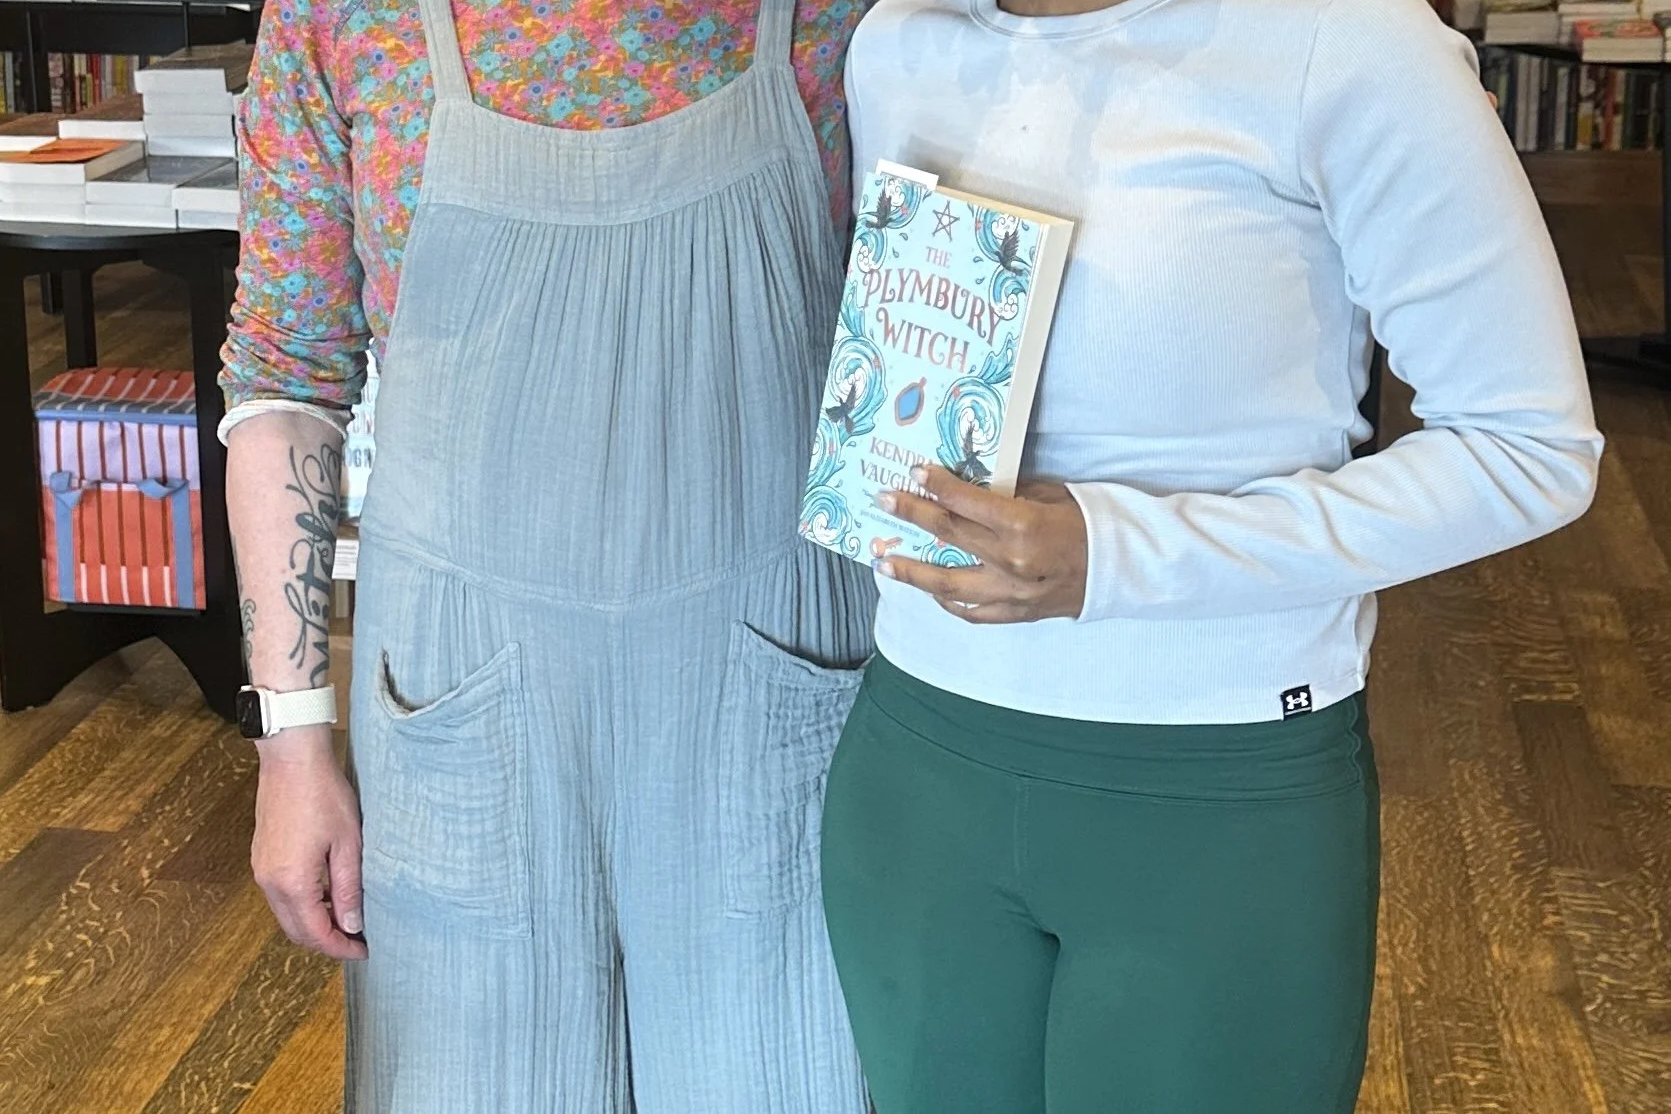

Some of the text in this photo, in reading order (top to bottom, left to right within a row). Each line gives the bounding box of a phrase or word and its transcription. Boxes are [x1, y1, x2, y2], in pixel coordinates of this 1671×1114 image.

[925, 245, 952, 270] THE
[861, 269, 1000, 346] PLYMBURY
[875, 307, 970, 373] WITCH
